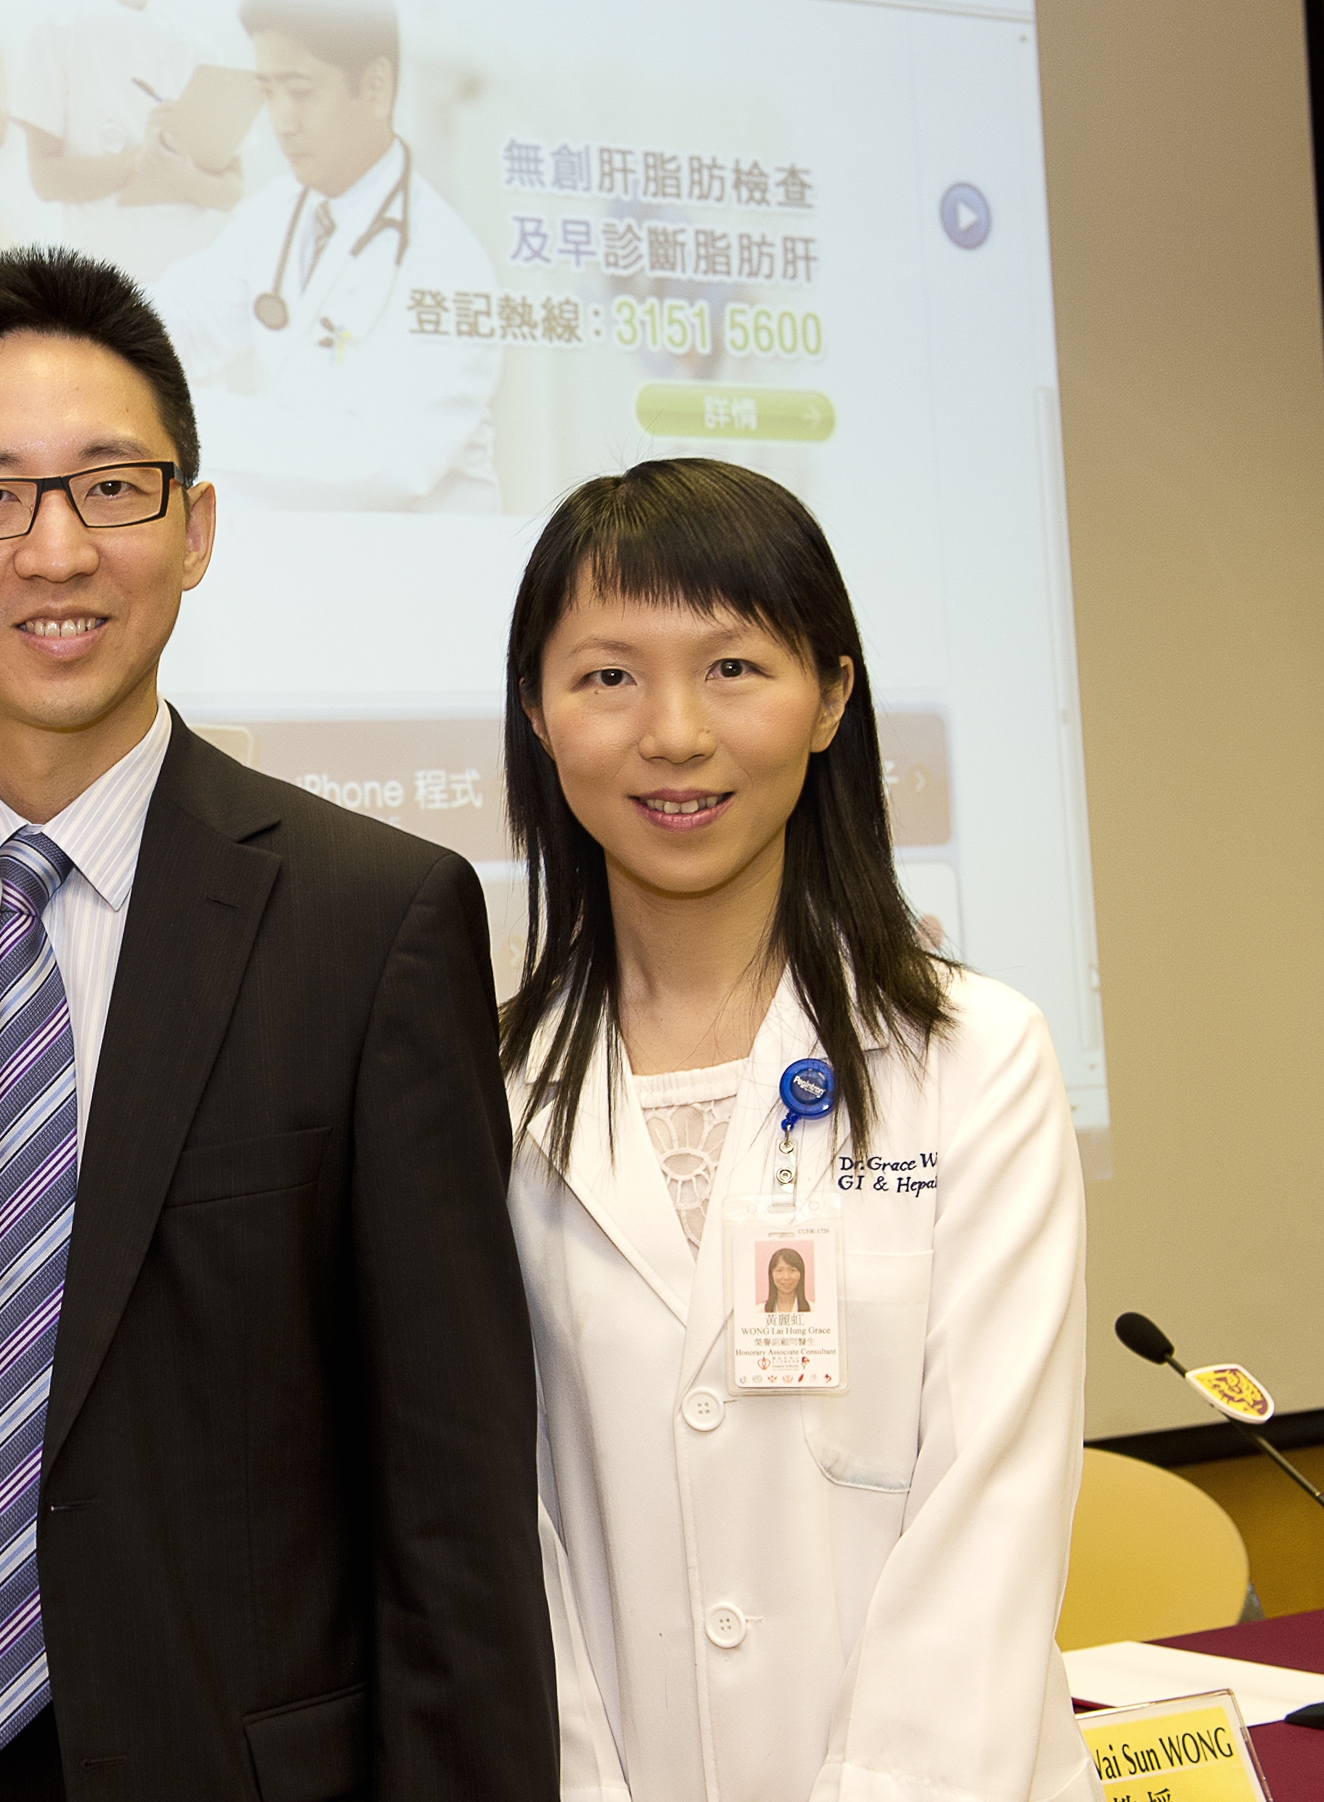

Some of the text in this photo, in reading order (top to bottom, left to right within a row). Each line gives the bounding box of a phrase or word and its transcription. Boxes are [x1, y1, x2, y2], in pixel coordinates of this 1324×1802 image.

[502, 138, 815, 210] 無創肝脂肪檢查
[509, 215, 820, 283] 及早診斷脂肪肝
[615, 299, 712, 353] 3151
[729, 308, 823, 357] 5600
[413, 768, 484, 810] 程式
[873, 1175, 889, 1191] &
[735, 1347, 836, 1357] Honorary Associate Consultant
[741, 1326, 831, 1336] WONG Lai Hung Grace
[1122, 1743, 1161, 1775] Sun
[1158, 1726, 1234, 1766] WONG
